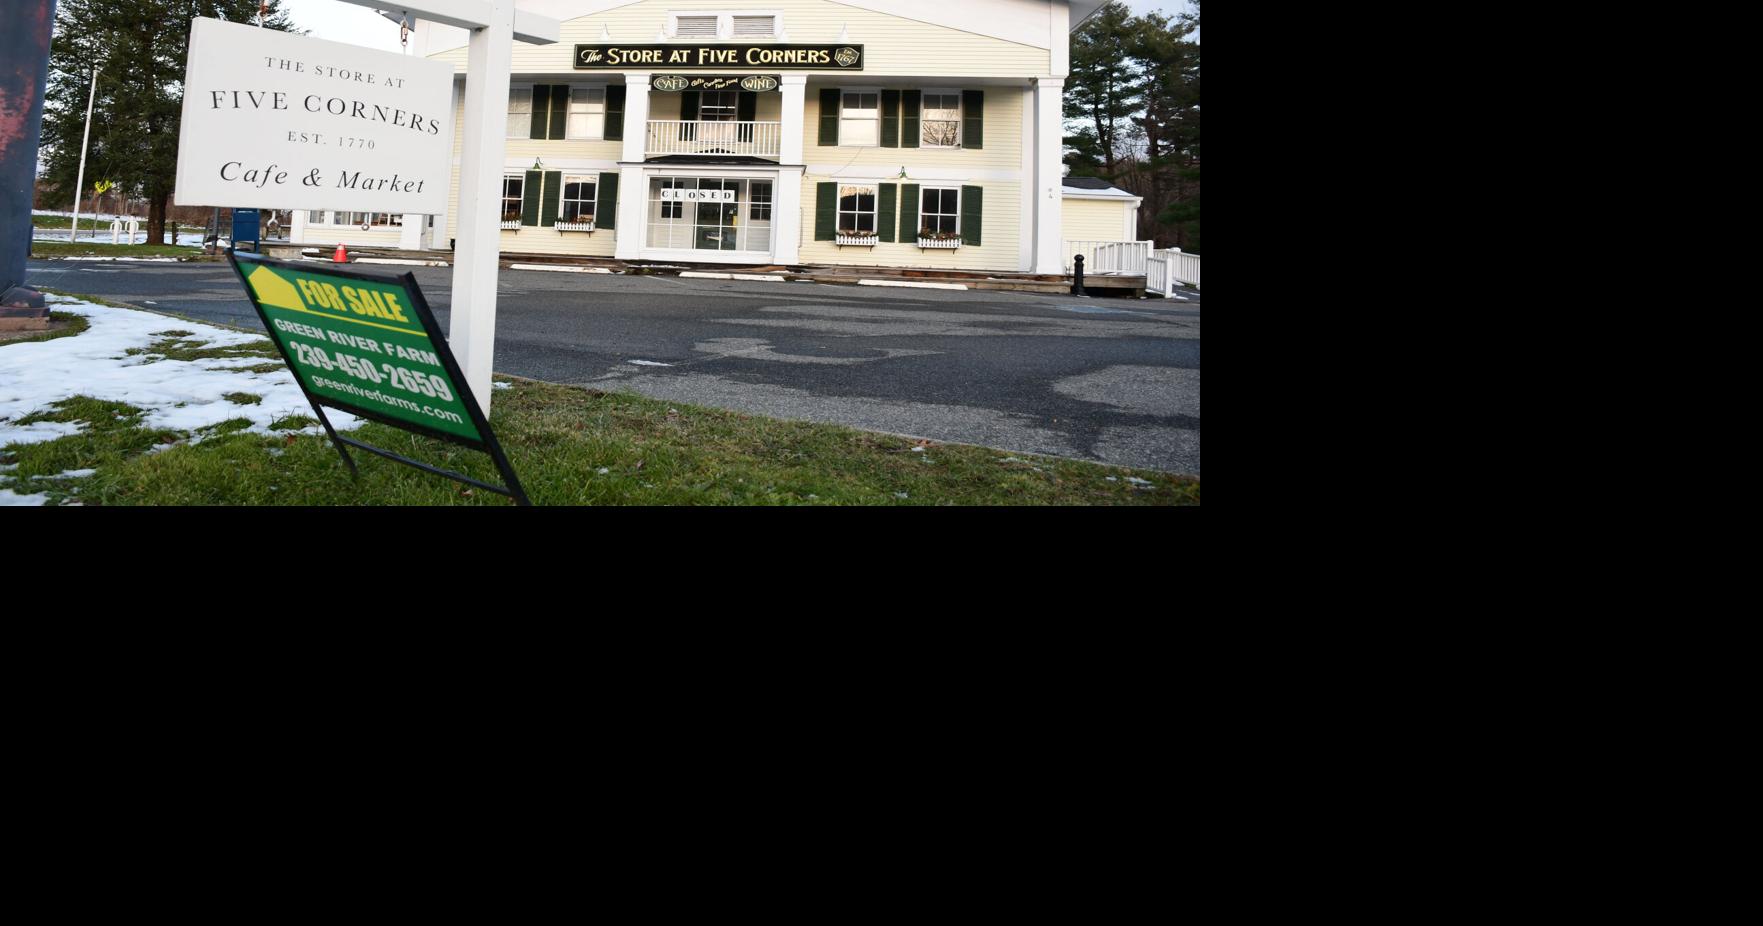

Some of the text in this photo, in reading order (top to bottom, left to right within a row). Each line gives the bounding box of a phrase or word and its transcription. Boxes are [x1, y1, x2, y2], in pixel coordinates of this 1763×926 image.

[264, 56, 406, 89] THE STORE AT
[580, 47, 830, 65] The STORE AT FIVE CORNERS
[744, 79, 772, 90] WINE
[210, 90, 440, 136] FIVE CORNERS
[287, 130, 376, 150] EST. 1770
[220, 161, 425, 194] Cafe & Market
[661, 190, 731, 199] CLOSED
[296, 278, 409, 324] FOR SALE
[274, 318, 440, 367] GREEN RIVER FARM
[290, 341, 454, 402] 239-450-2659
[311, 375, 464, 424] greenriverfarms.com
